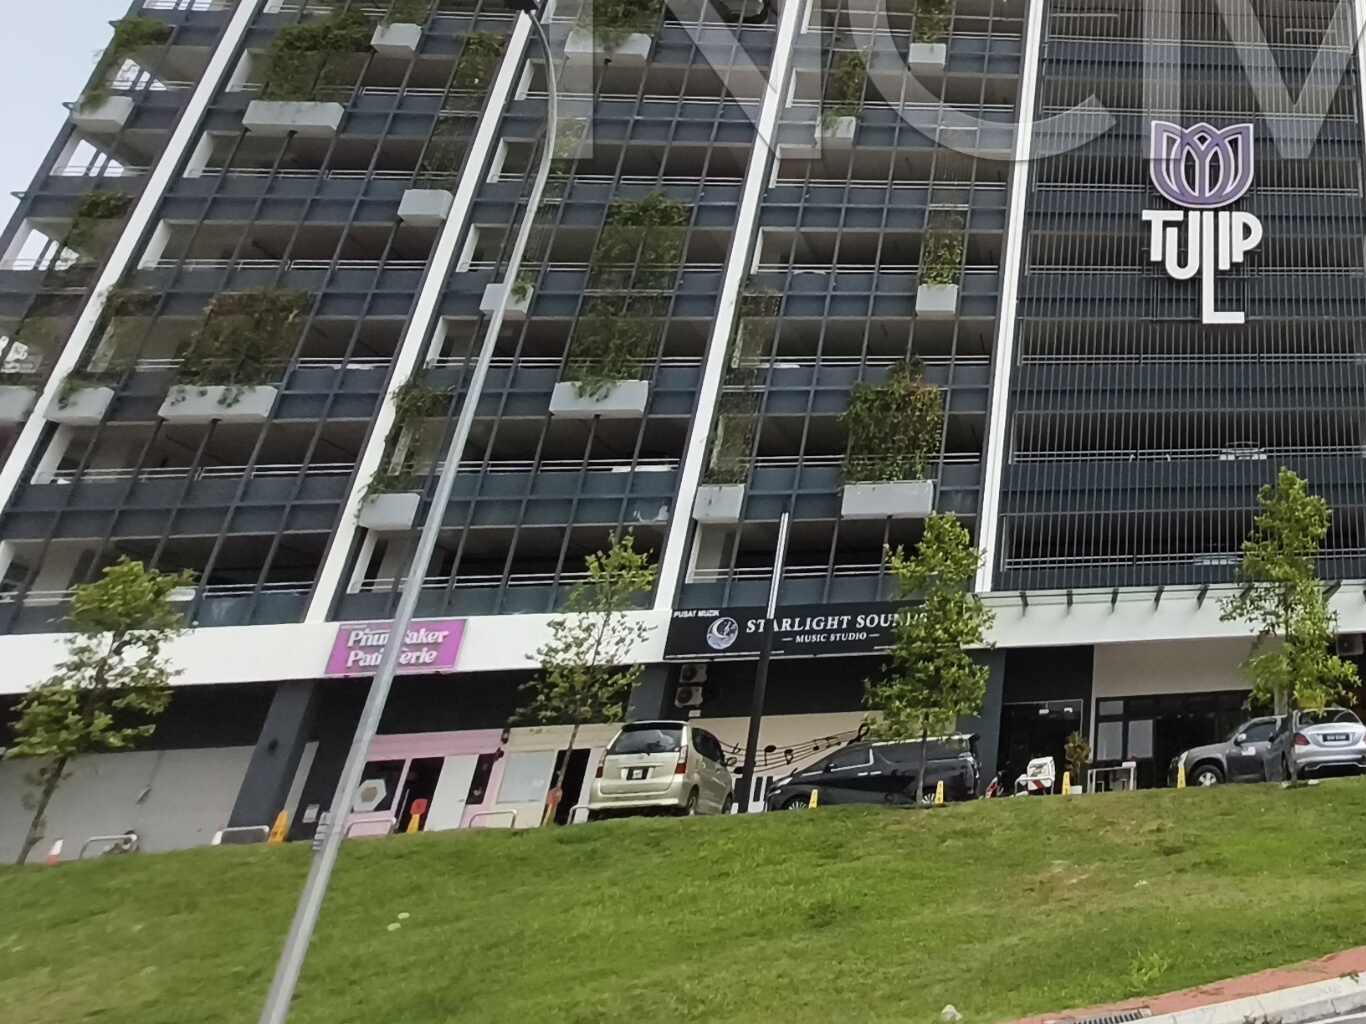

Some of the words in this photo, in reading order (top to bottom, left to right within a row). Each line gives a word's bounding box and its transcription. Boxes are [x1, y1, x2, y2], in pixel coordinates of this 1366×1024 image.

[1142, 209, 1263, 324] TULIP
[795, 634, 827, 643] MUSIC
[829, 631, 867, 641] STUDIO
